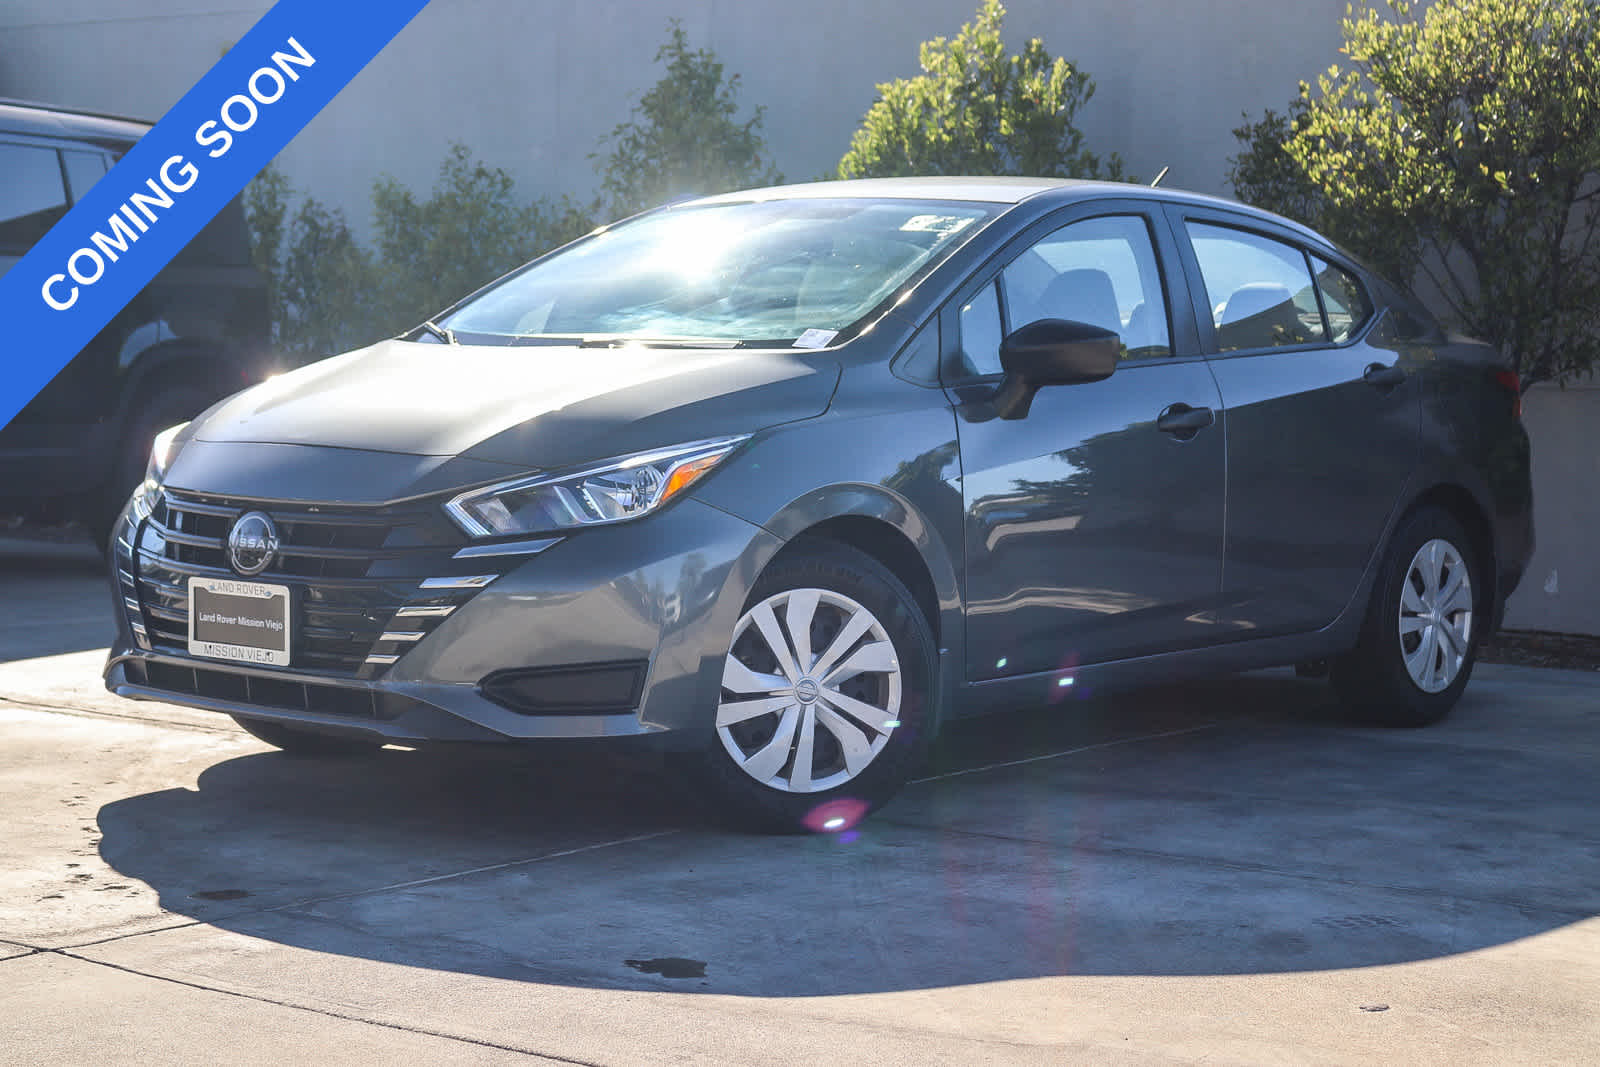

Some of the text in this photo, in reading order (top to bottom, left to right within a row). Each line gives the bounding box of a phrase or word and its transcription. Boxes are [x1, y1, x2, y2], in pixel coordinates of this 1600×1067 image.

[236, 585, 265, 596] ROVER
[199, 612, 283, 632] Land Rover Mission Viejo
[204, 645, 274, 663] MISSION VIEJO
